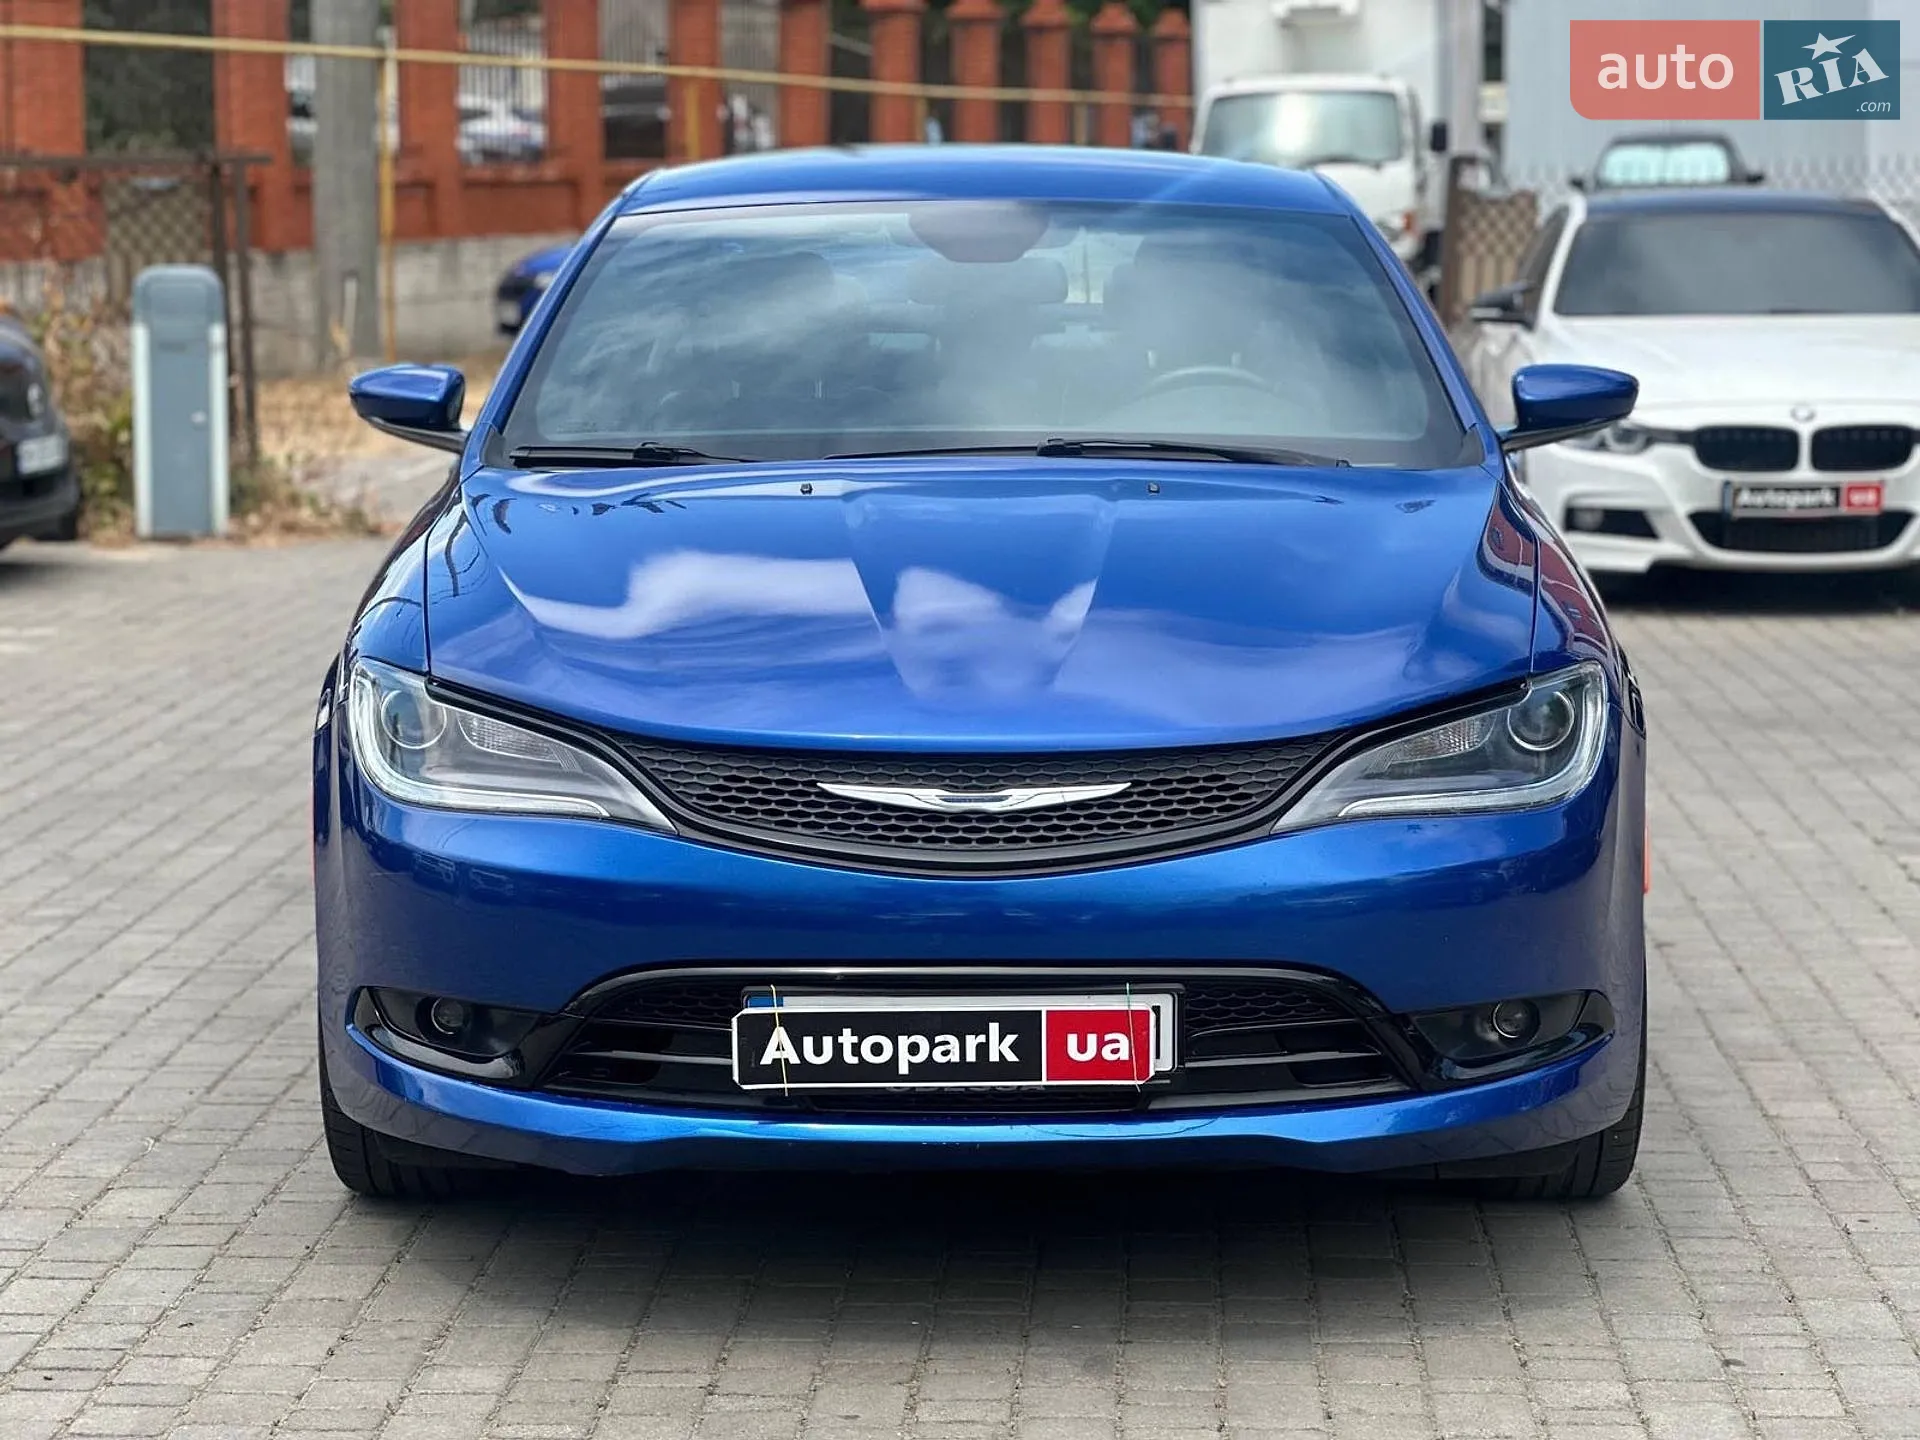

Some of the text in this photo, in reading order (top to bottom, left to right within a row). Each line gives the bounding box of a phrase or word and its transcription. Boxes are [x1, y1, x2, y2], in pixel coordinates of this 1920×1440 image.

[1737, 487, 1836, 512] Autopark
[759, 1022, 1131, 1076] Autopark ua
